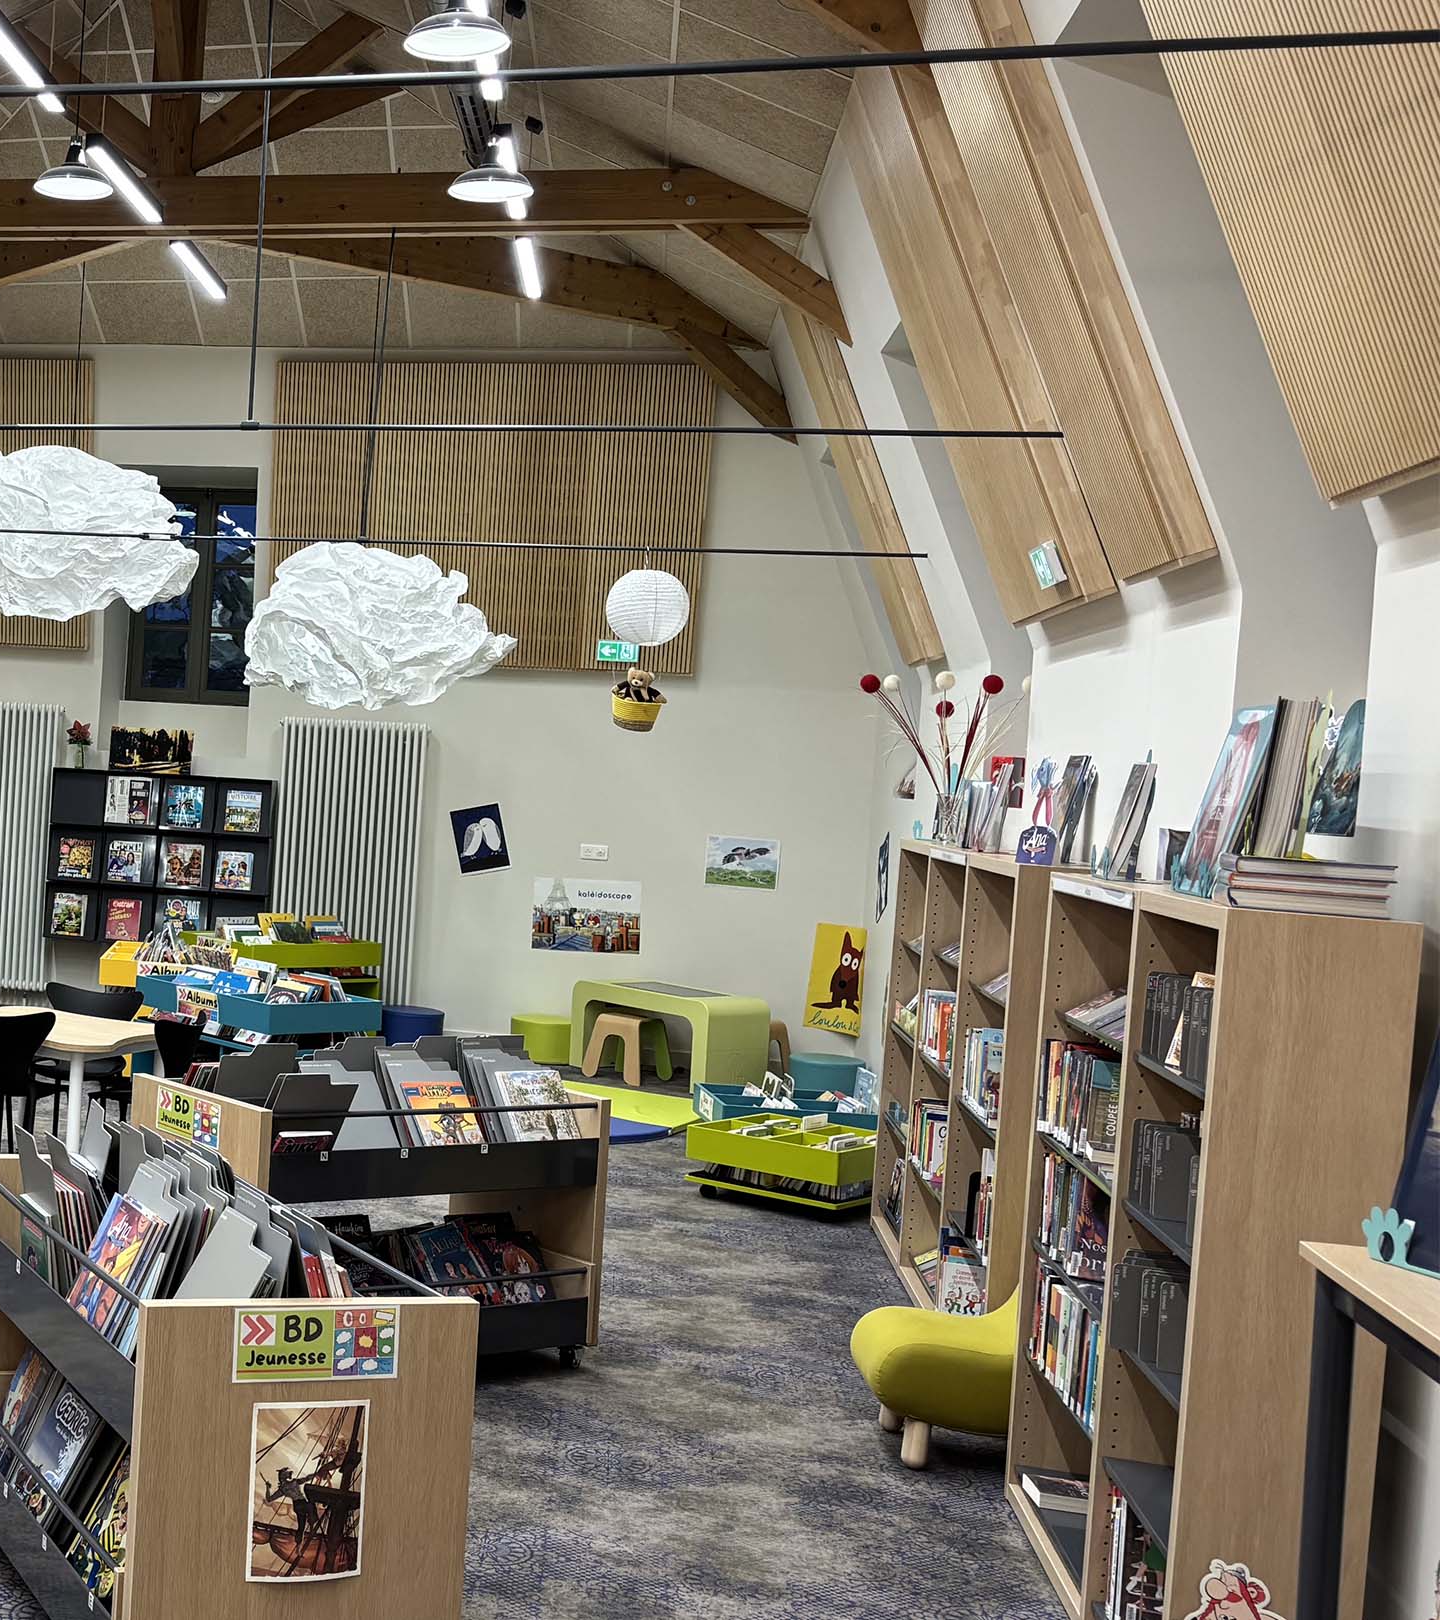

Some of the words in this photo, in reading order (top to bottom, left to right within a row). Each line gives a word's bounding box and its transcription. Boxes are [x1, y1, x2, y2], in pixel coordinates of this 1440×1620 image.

[1022, 827, 1048, 849] Ana
[186, 991, 218, 1008] Albums
[173, 1095, 190, 1115] BD
[160, 1111, 191, 1131] Jeunesse
[107, 1214, 133, 1241] Ana
[1081, 1238, 1107, 1254] Nos
[283, 1314, 324, 1343] BD
[245, 1349, 327, 1367] Jeunesse
